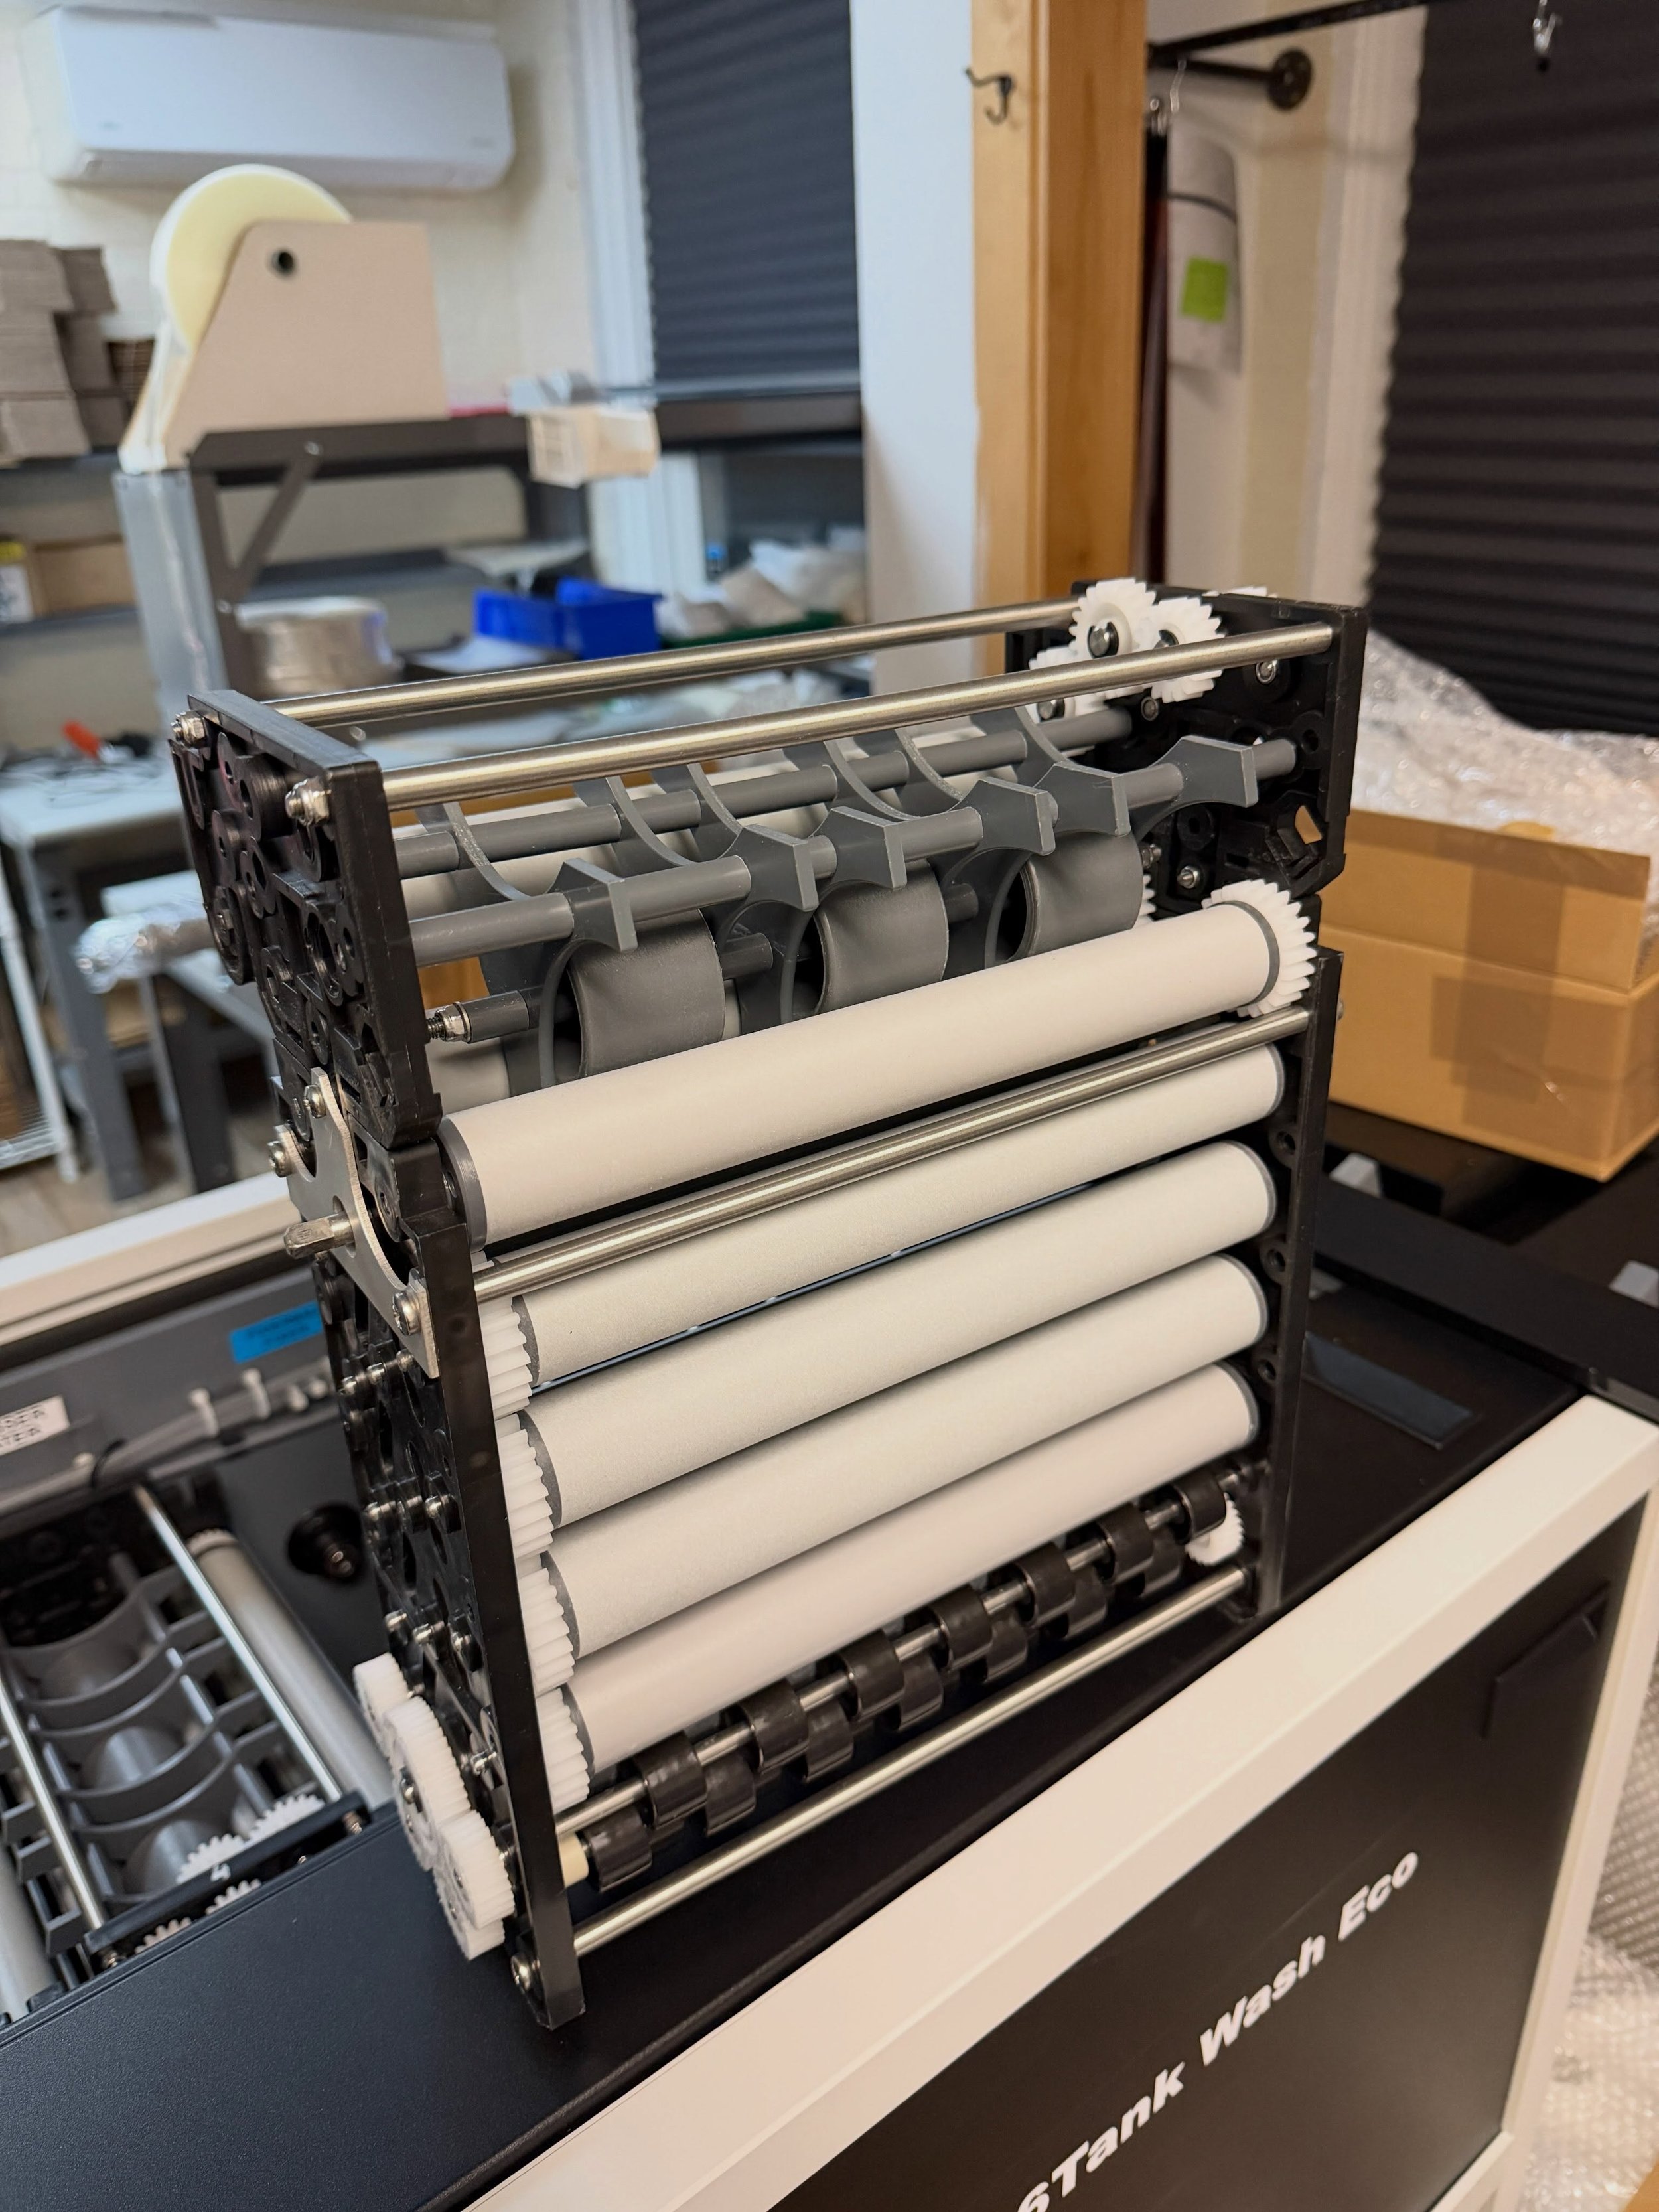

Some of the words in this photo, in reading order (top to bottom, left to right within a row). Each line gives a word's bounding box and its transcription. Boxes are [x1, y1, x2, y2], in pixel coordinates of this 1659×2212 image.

[1017, 2061, 1185, 2212] 6Tank
[1200, 1935, 1325, 2066] Wash
[1338, 1852, 1418, 1941] Eco
